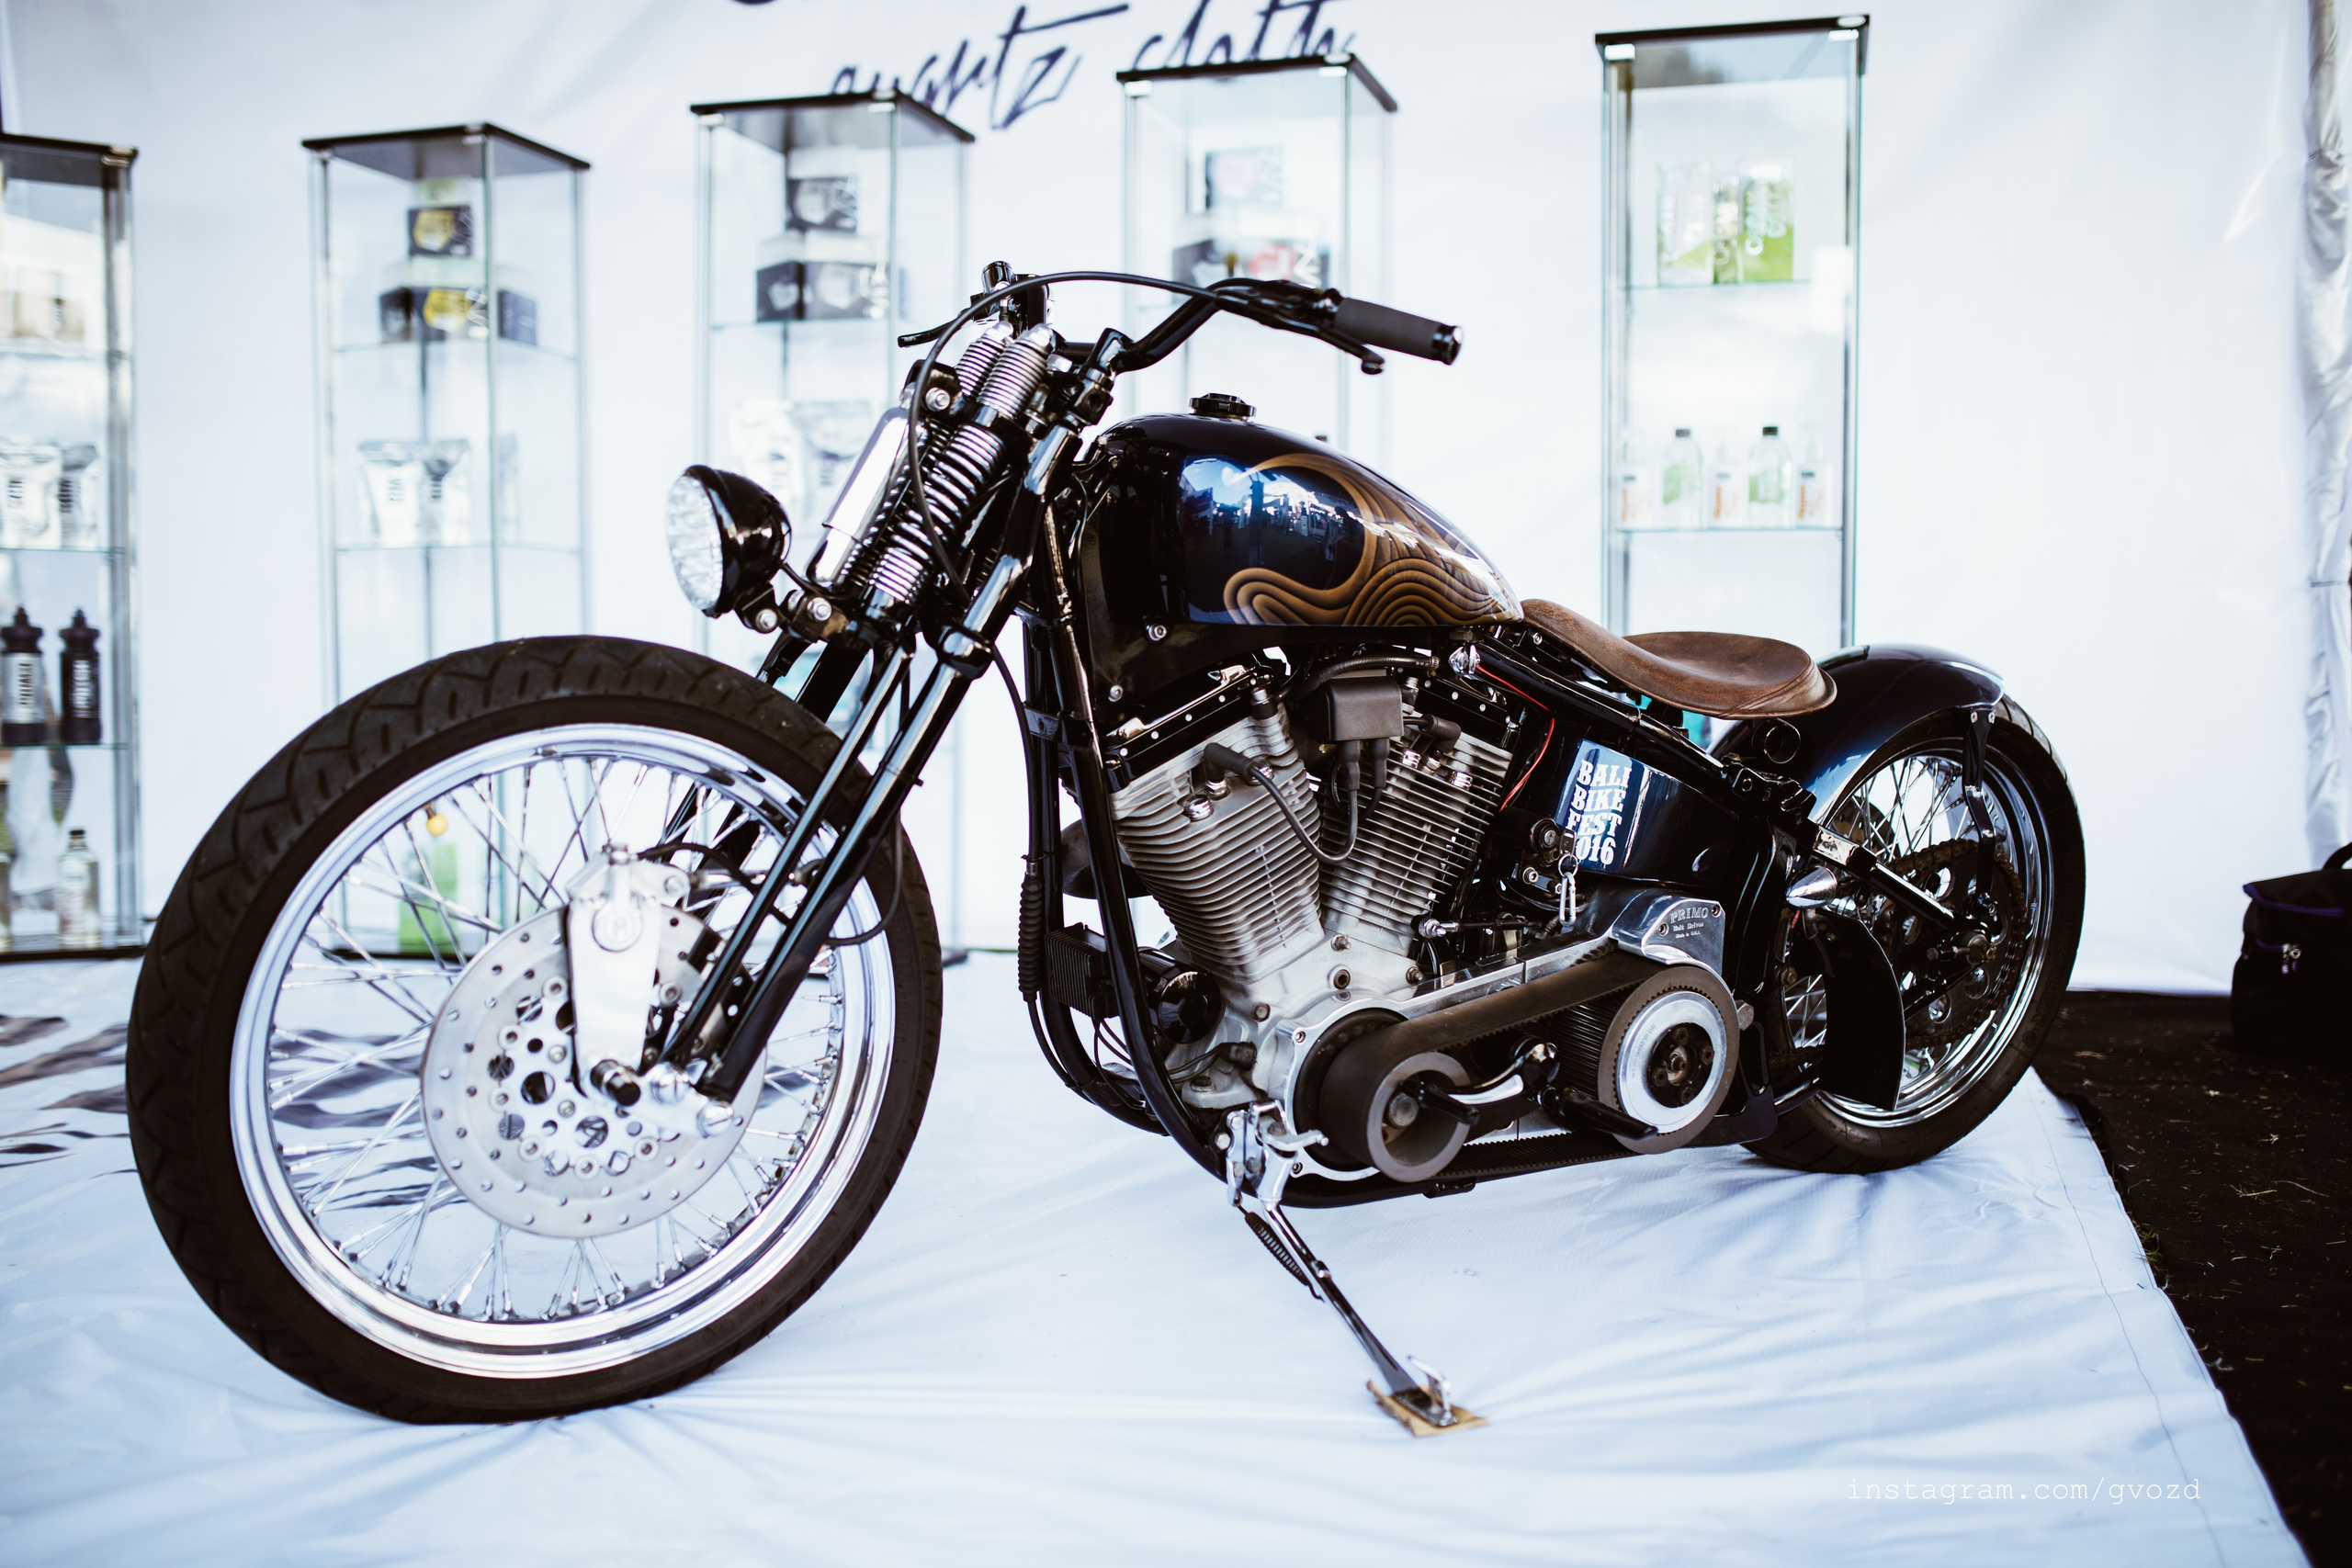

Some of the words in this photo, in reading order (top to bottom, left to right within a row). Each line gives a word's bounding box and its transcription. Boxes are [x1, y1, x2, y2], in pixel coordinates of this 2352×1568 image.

[1577, 760, 1633, 788] BALI
[1571, 784, 1626, 812] BIKE
[1565, 808, 1623, 837] FEST
[1575, 836, 1616, 865] 016
[1669, 907, 1709, 924] PRIMO
